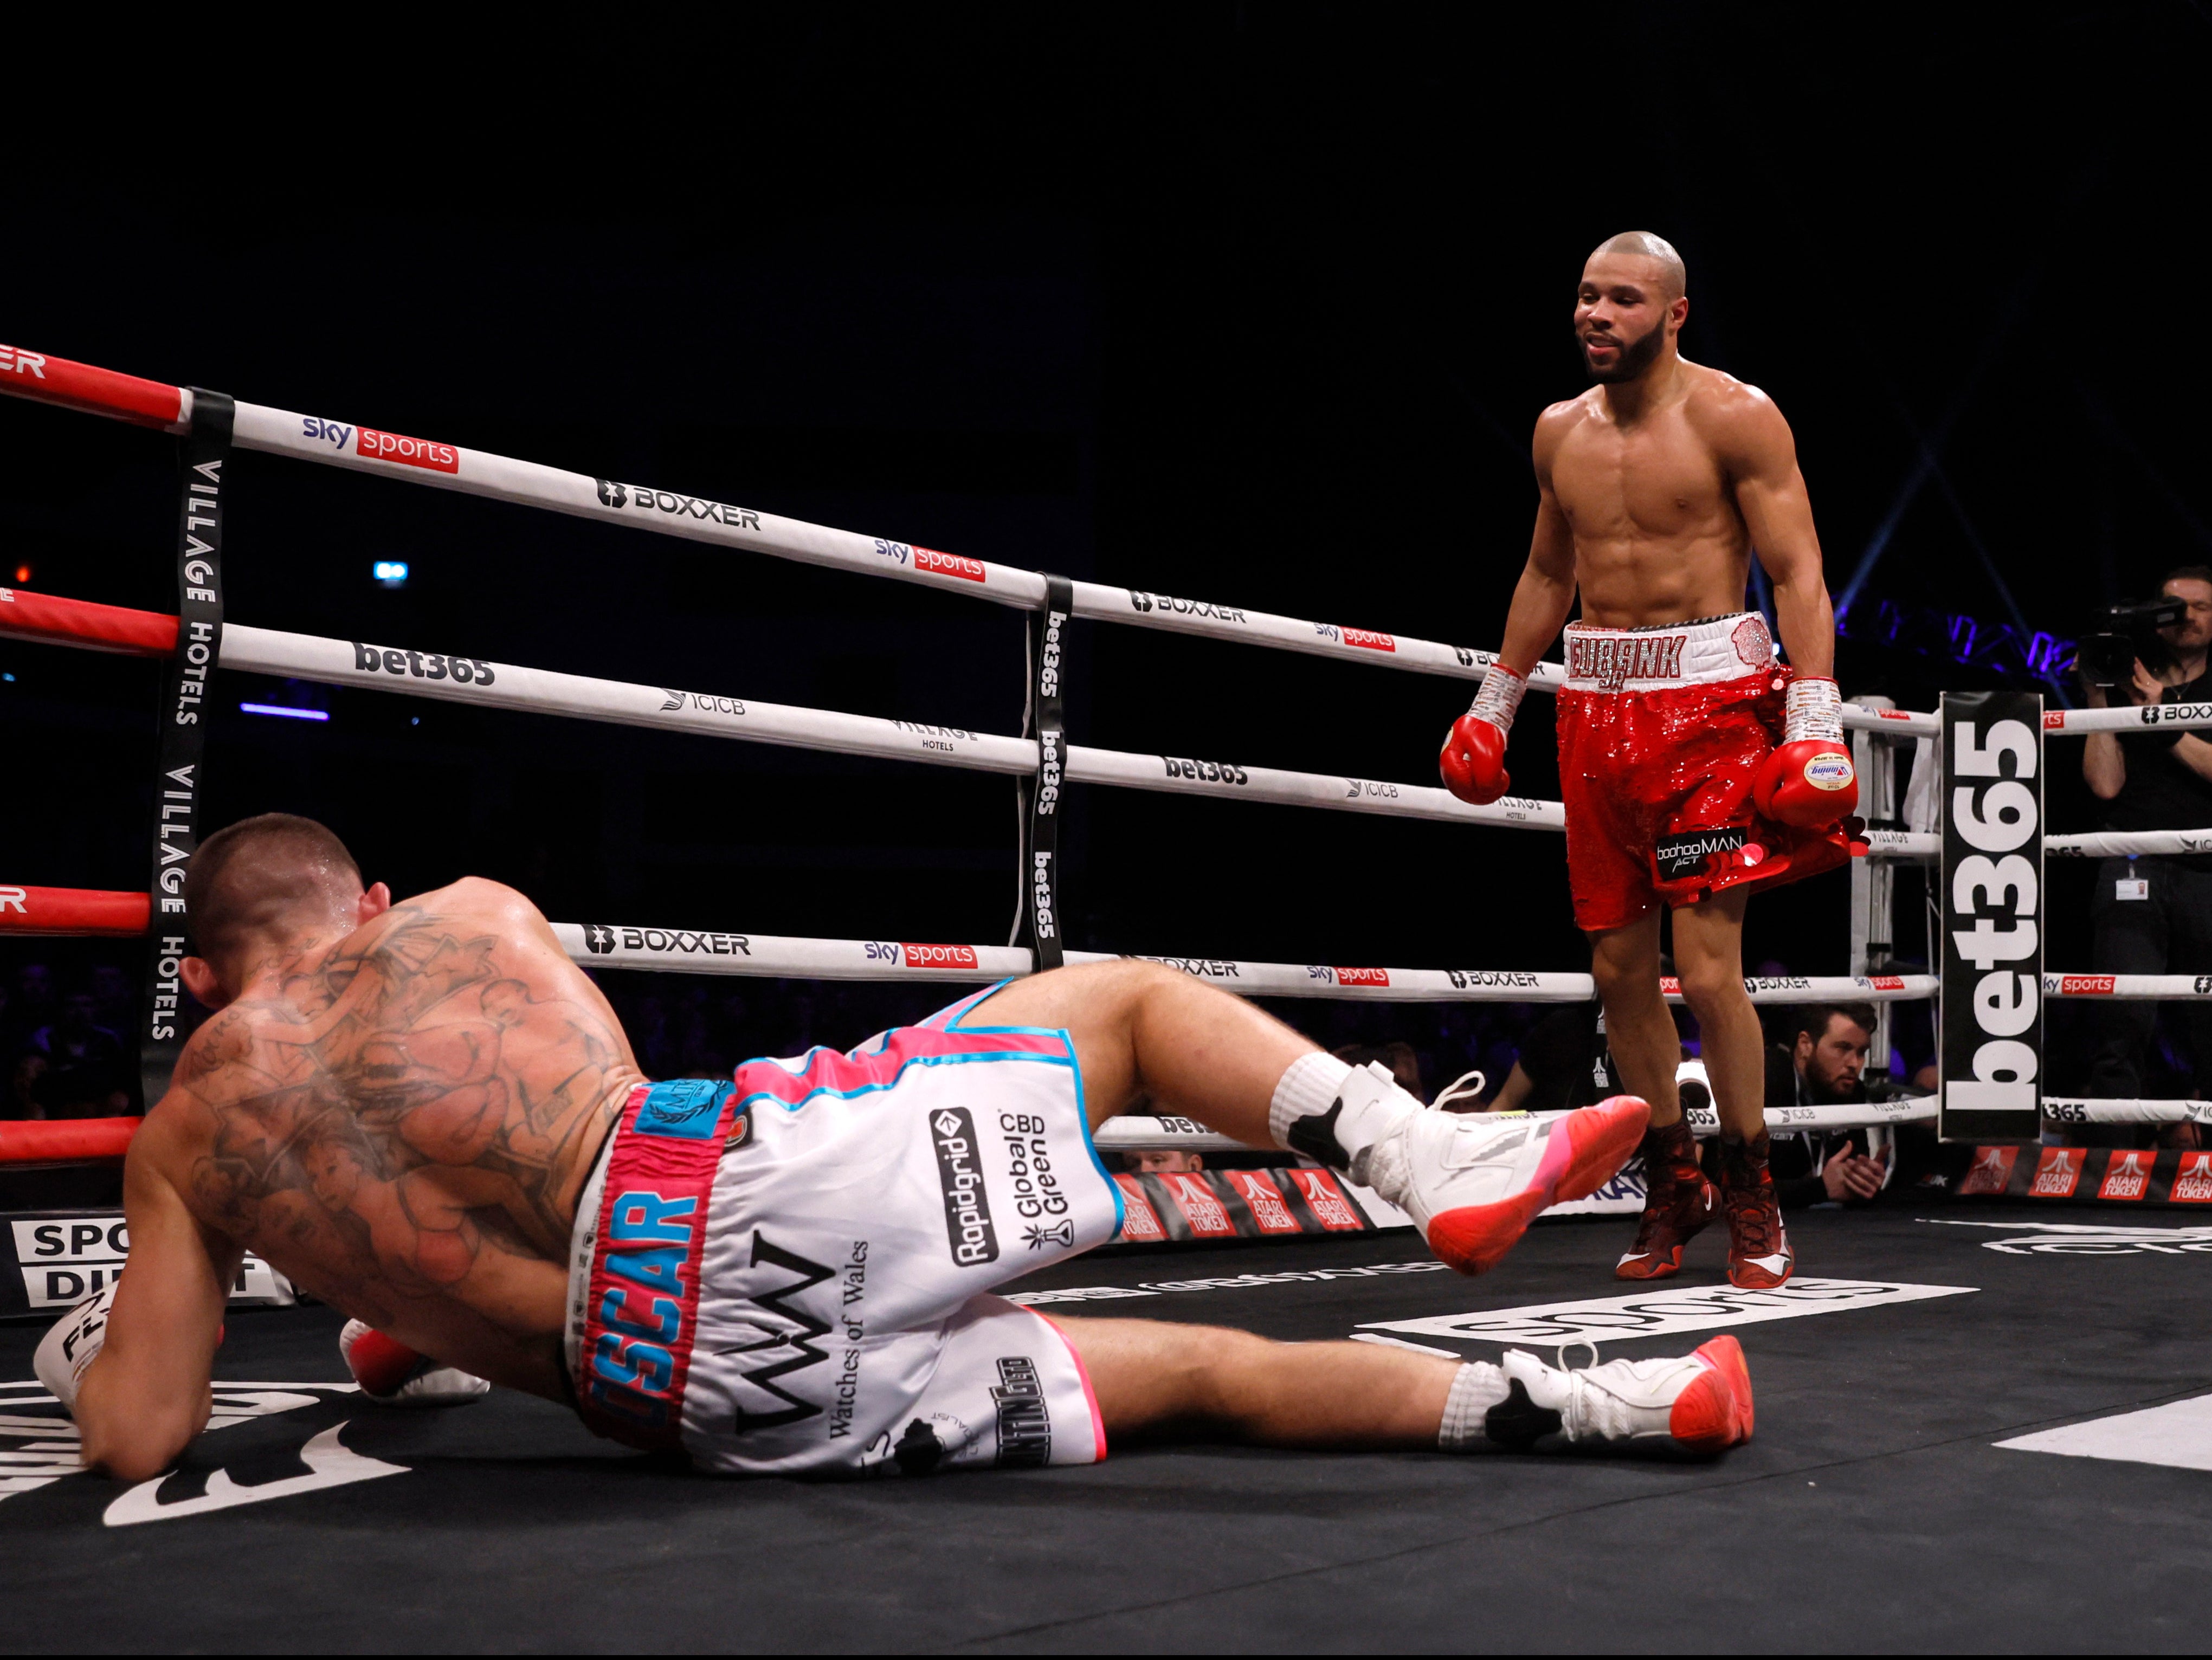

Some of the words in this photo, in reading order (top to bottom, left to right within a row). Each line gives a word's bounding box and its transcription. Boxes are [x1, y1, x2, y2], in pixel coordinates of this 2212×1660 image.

[303, 418, 352, 449] sky
[362, 429, 454, 464] sports
[634, 487, 761, 531] BOXXER
[185, 460, 222, 603] VILLAGE
[874, 539, 909, 564] sky
[918, 547, 983, 576] sports
[1157, 595, 1247, 624] BOXXER
[1315, 623, 1339, 641] sky
[1345, 626, 1393, 647] sports
[354, 642, 495, 686] bet365
[1041, 611, 1067, 698] bet365
[1568, 635, 1688, 678] EUBANK
[176, 622, 213, 726] HOTELS
[691, 693, 746, 715] ICICB
[923, 739, 953, 752] HOTELS
[1037, 730, 1060, 815] bet365
[1163, 758, 1248, 786] bet365
[1365, 783, 1398, 798] ICICB
[160, 764, 195, 913] VILLAGE
[1658, 835, 1742, 860] boohooMAN
[1672, 856, 1700, 873] ACT
[1035, 851, 1055, 939] bet365
[1946, 719, 2039, 1110] bet365
[624, 928, 751, 956] BOXXER
[865, 942, 899, 965] sky
[908, 945, 973, 964] sports
[1307, 966, 1333, 983] sky
[1339, 968, 1386, 982] sports
[1470, 971, 1539, 987] BOXXER
[2064, 979, 2111, 992] sports
[152, 937, 185, 1041] HOTELS
[1000, 1114, 1045, 1134] CBD
[1004, 1136, 1042, 1218] Global
[1031, 1140, 1068, 1215] Green
[2035, 1182, 2069, 1193] TOKEN
[2037, 1173, 2073, 1184] ATARI
[2105, 1186, 2139, 1196] TOKEN
[2106, 1176, 2143, 1189] ATARI
[939, 1136, 989, 1264] Rapidgrid
[1185, 1202, 1223, 1216] ATARI
[1253, 1200, 1286, 1215] ATARI
[1312, 1199, 1346, 1213] ATARI
[1190, 1216, 1229, 1231] TOKEN
[1257, 1214, 1294, 1229] TOKEN
[843, 1240, 868, 1307] Wales
[1449, 1279, 1901, 1337] sports
[844, 1318, 862, 1341] of
[829, 1349, 859, 1439] Watches
